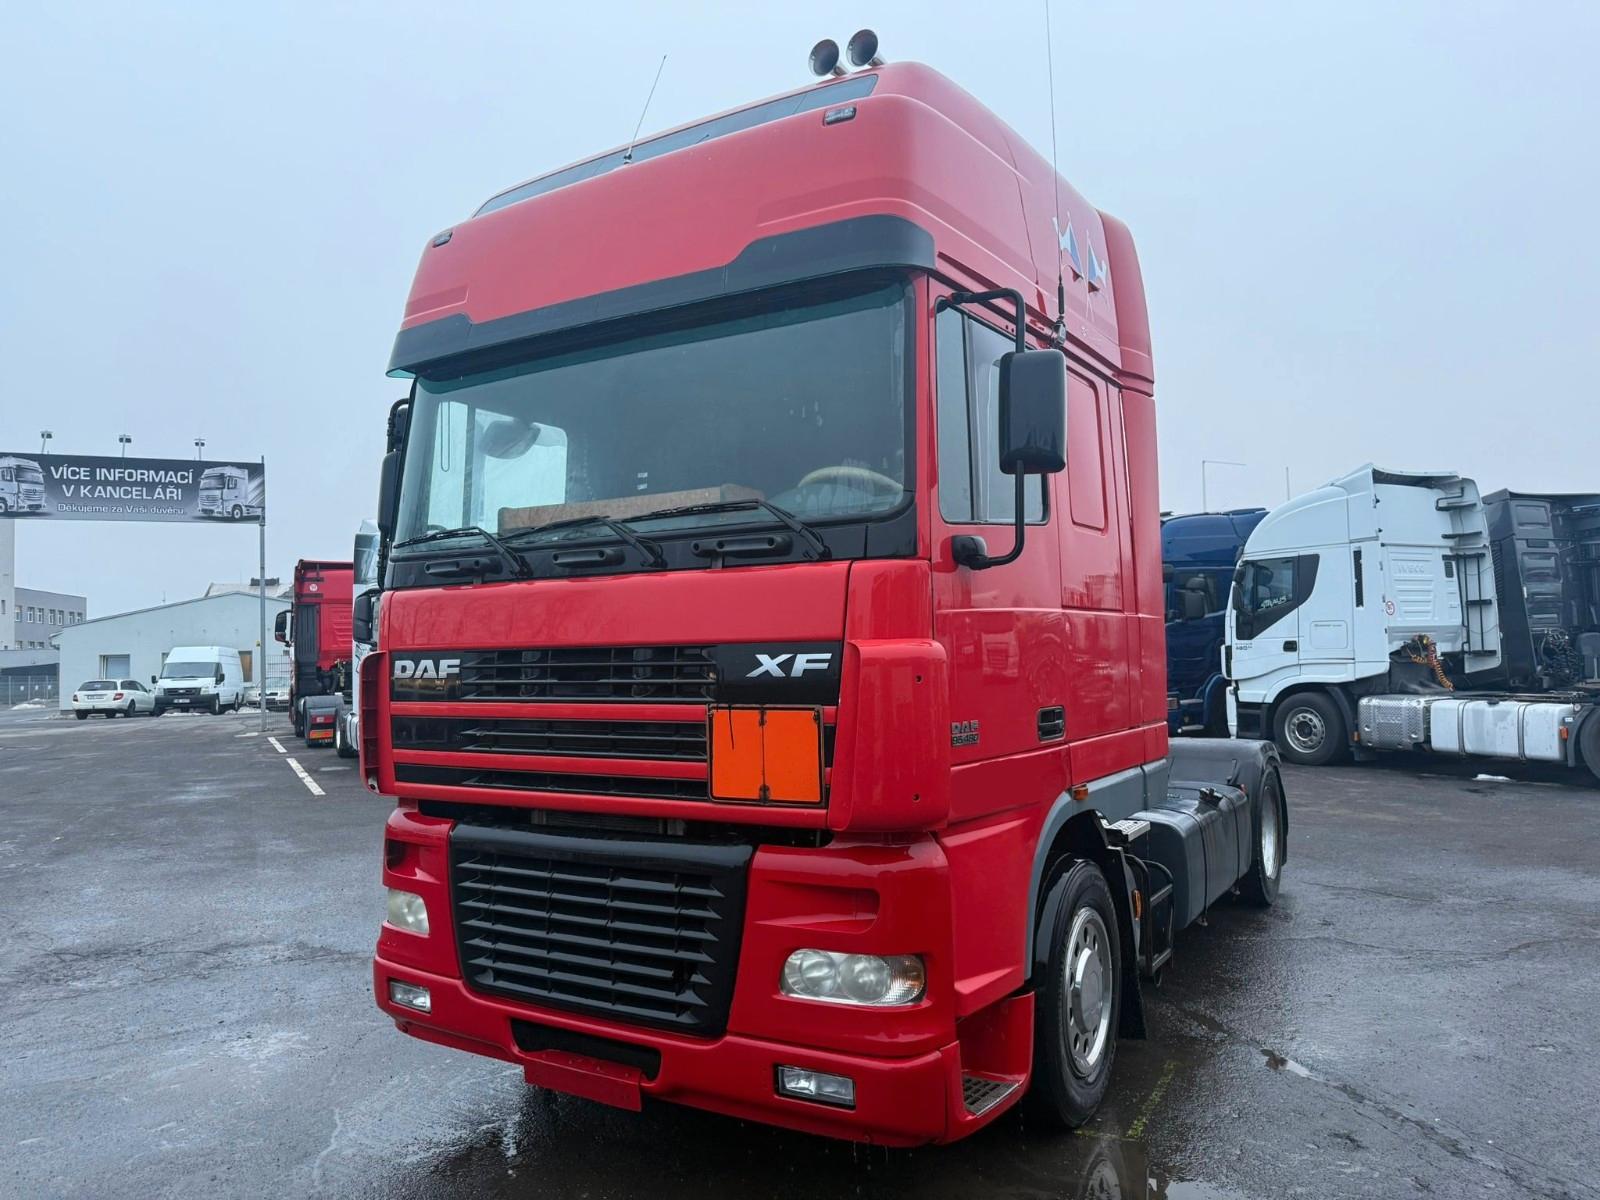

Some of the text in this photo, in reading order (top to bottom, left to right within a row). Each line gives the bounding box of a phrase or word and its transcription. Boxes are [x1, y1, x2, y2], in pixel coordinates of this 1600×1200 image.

[50, 464, 194, 484] VÍCE INFORMACÍ
[62, 484, 182, 501] V KANCELÁŘI
[393, 658, 461, 680] DAF
[744, 652, 833, 678] XF
[951, 720, 980, 734] DAF
